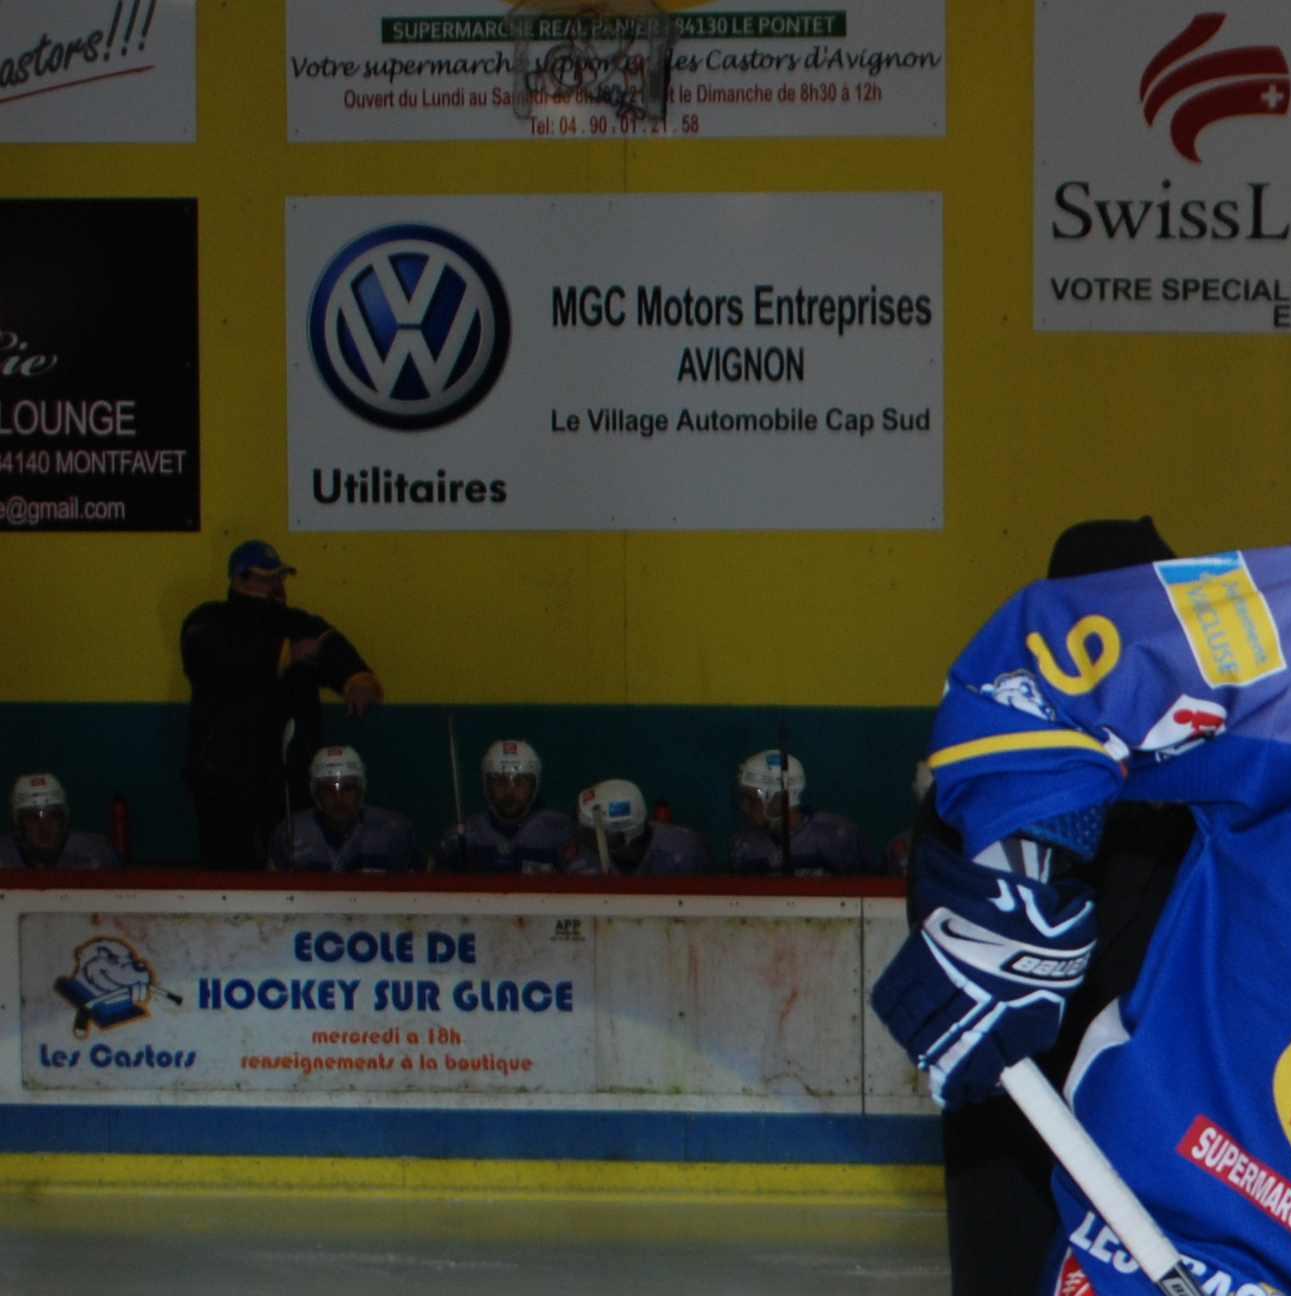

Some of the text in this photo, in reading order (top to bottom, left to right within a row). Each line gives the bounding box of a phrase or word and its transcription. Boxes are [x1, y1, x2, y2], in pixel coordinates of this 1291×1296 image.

[732, 17, 753, 33] LE
[759, 16, 836, 33] PONTET
[290, 56, 359, 80] Votre
[364, 50, 522, 82] supermarch
[707, 48, 797, 72] Castors
[805, 45, 941, 76] d'Avignon
[344, 90, 394, 110] Ouvert
[399, 89, 418, 108] du
[422, 89, 465, 108] Lundi
[469, 91, 487, 108] au
[679, 85, 691, 103] le
[697, 84, 772, 104] Dimanche
[778, 83, 796, 102] de
[801, 82, 836, 102] 8h30
[855, 81, 882, 101] 12h
[559, 117, 577, 135] 04
[590, 116, 608, 135] 90
[681, 115, 699, 134] 58
[1051, 278, 1152, 301] VOTRE
[552, 284, 932, 336] MGC Motors Entreprises
[677, 346, 804, 382] AVIGNON
[551, 407, 931, 437] Le Village Automobile Cap Sud
[55, 450, 187, 475] MONTFAVET
[312, 466, 508, 504] Utilitaires
[294, 931, 477, 964] ECOLE DE
[198, 977, 574, 1013] HOCKEY SUR GLACE
[311, 1026, 400, 1046] mercredi
[427, 1027, 462, 1046] 18h
[40, 1043, 196, 1069] Les Castors
[240, 1053, 395, 1075] renseignements
[420, 1055, 439, 1071] la
[444, 1054, 533, 1077] boutique
